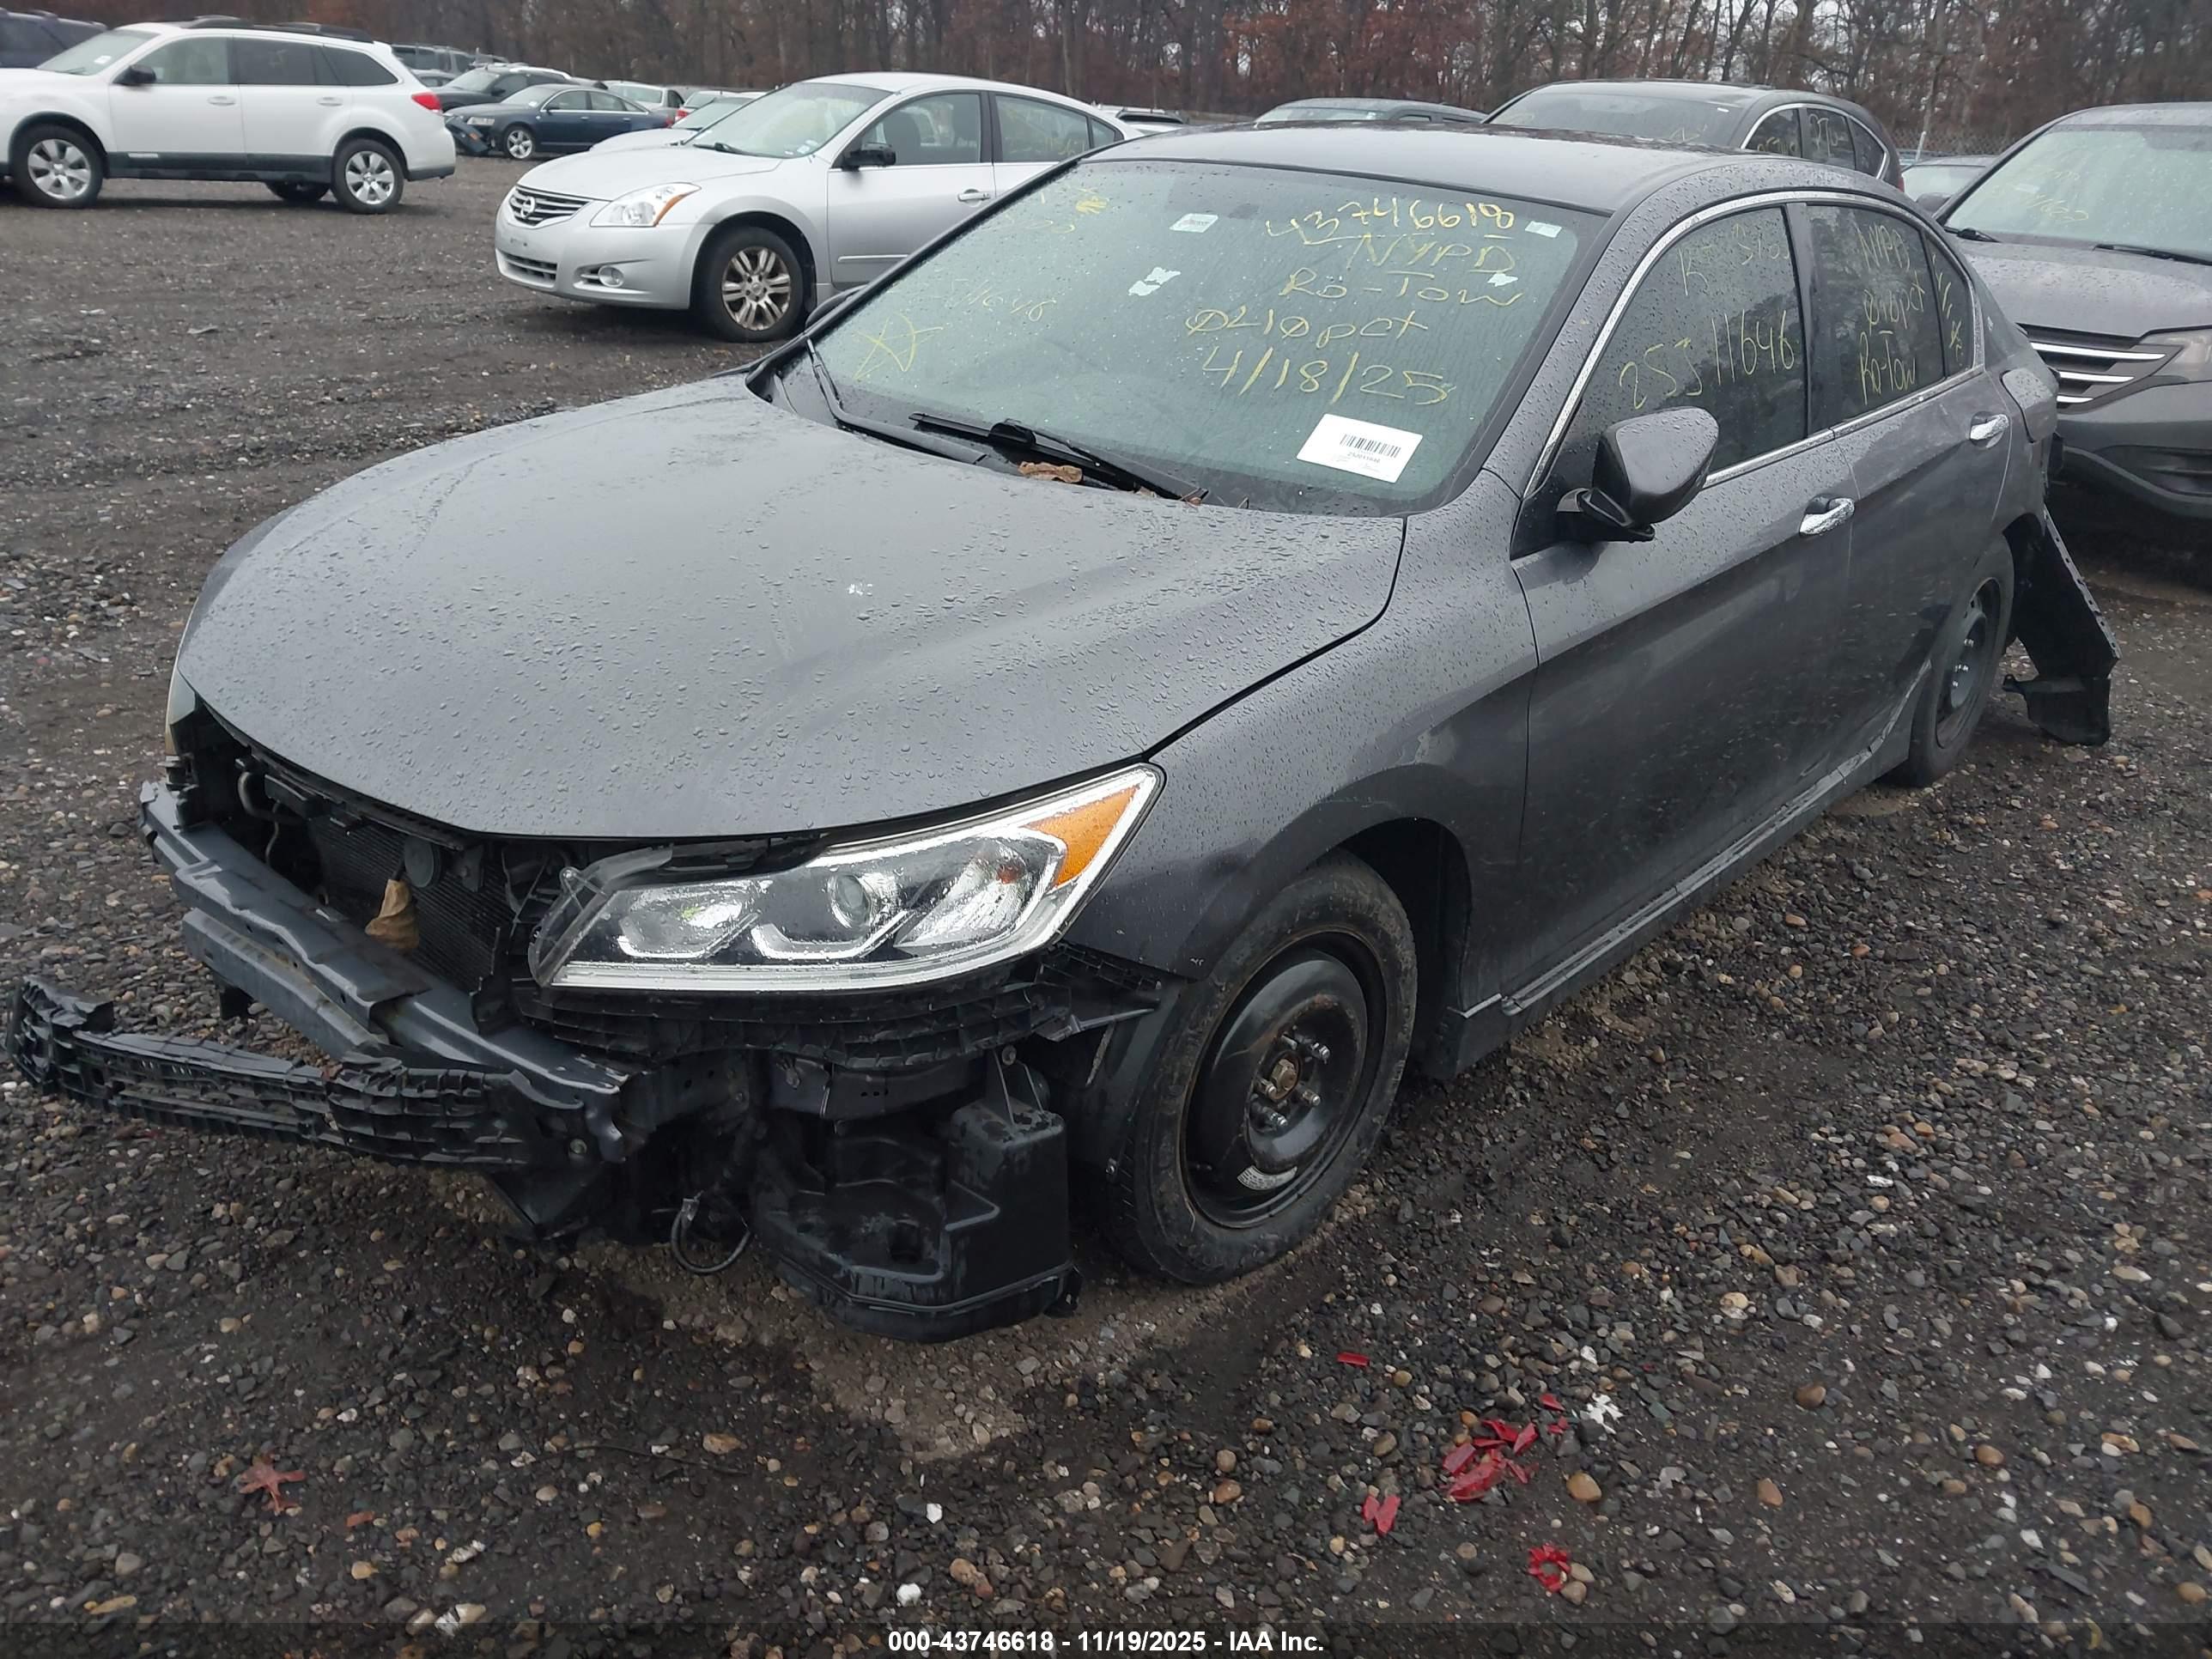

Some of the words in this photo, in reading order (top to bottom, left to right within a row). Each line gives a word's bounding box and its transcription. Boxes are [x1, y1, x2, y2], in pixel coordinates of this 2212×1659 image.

[1266, 197, 1515, 244] 43746618
[1346, 233, 1516, 273] NYPD
[1201, 345, 1456, 405] 4/18/25
